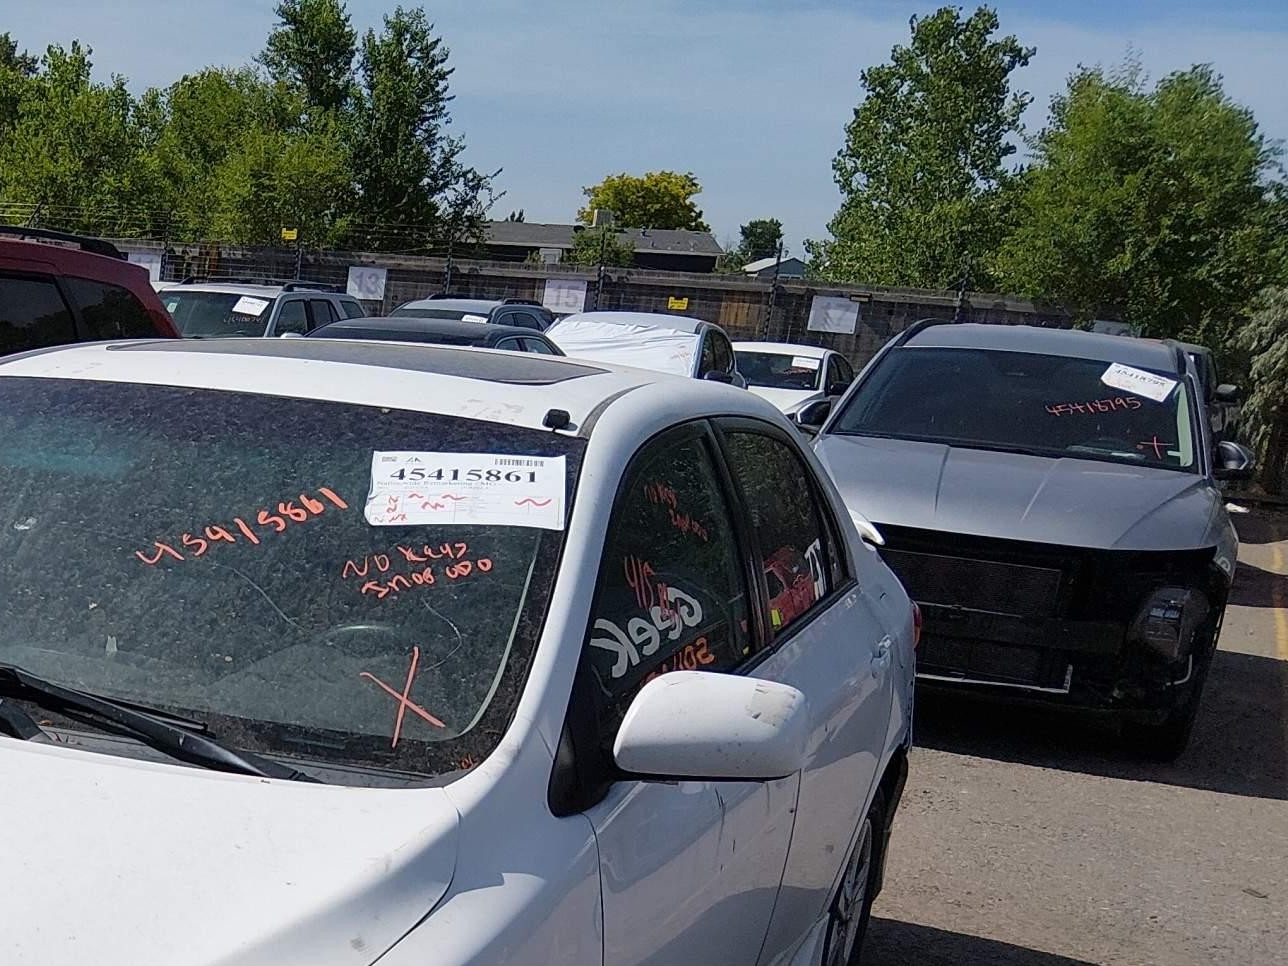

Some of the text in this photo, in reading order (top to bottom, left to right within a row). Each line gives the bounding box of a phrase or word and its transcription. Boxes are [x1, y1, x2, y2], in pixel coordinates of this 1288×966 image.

[355, 271, 380, 294] 13
[1045, 396, 1142, 417] 45418795
[390, 467, 537, 483] 45415861
[135, 487, 349, 564] 45415861
